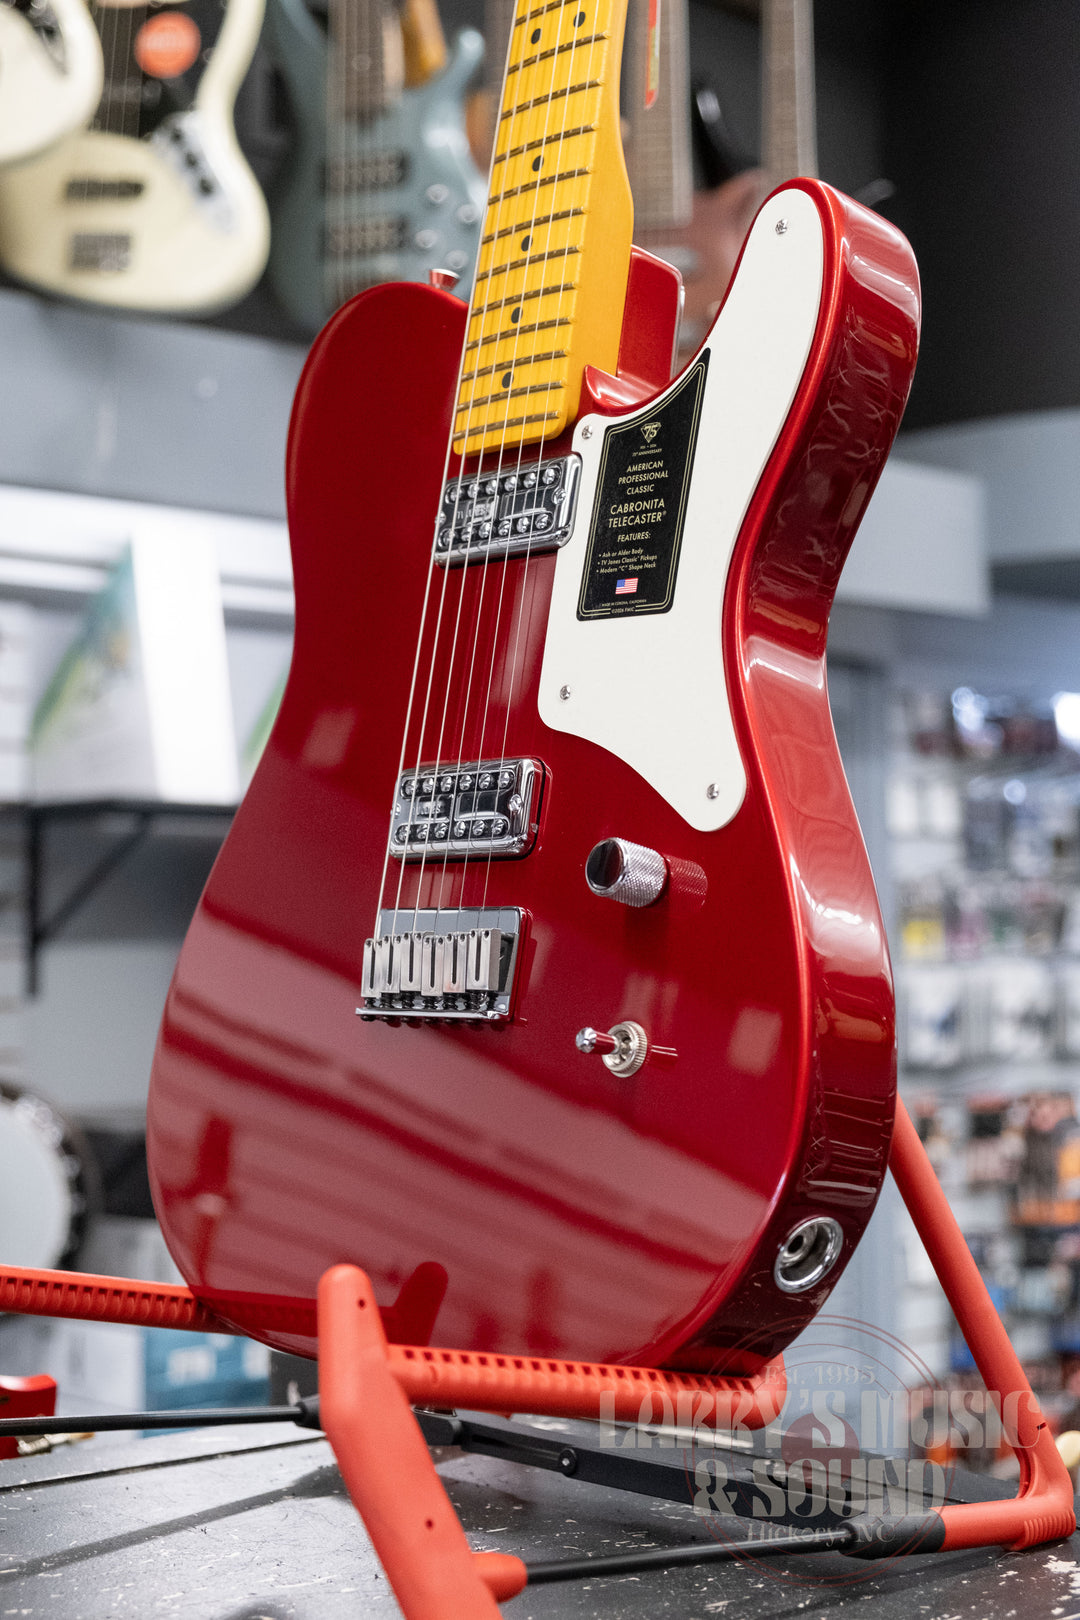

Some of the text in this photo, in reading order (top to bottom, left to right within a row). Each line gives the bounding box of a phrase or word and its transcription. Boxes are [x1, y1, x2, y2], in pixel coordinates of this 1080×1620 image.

[626, 460, 664, 473] AMERICAN
[618, 470, 669, 485] PROFESSIONAL
[626, 484, 655, 495] CLASSIC
[610, 498, 665, 515] CABRONITA
[617, 531, 651, 543] FEATURES:
[631, 547, 644, 555] Body
[640, 554, 658, 562] Pickups
[600, 566, 618, 574] Modern
[628, 564, 643, 572] Shape
[643, 561, 656, 569] Neck
